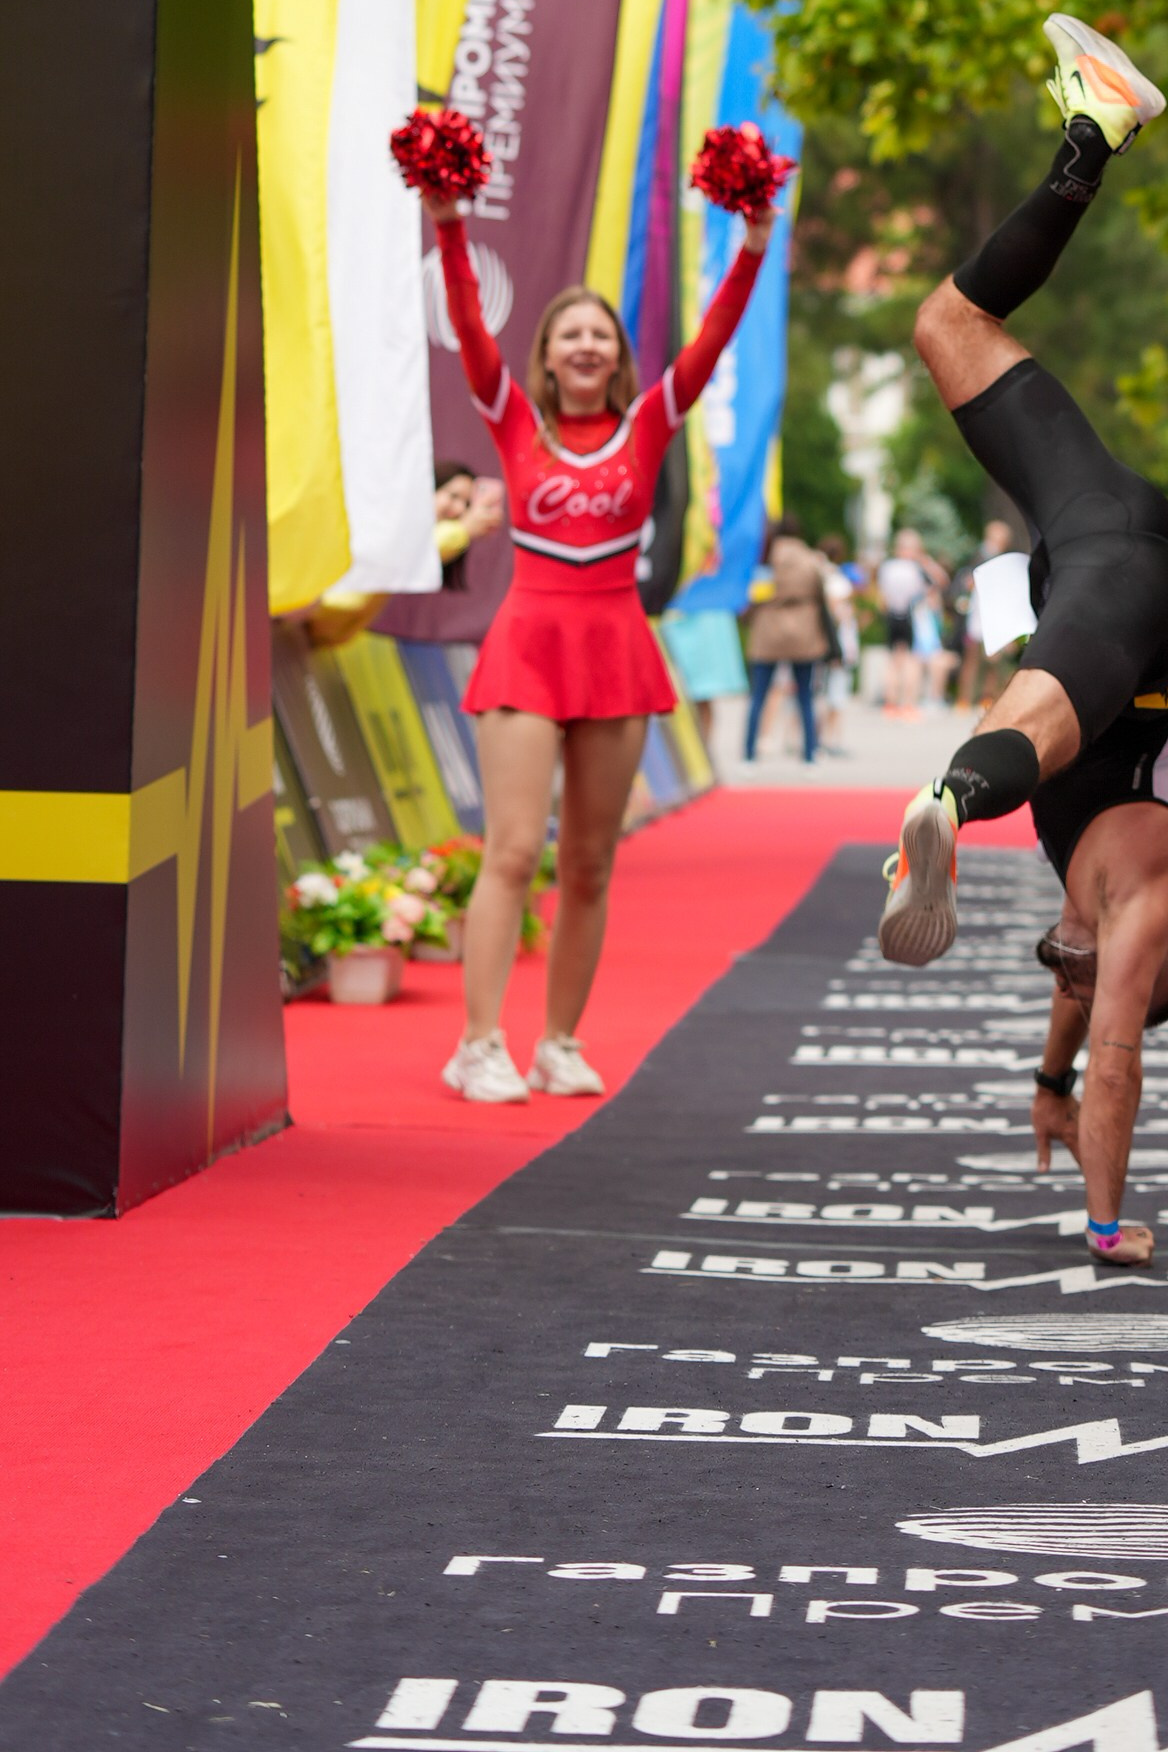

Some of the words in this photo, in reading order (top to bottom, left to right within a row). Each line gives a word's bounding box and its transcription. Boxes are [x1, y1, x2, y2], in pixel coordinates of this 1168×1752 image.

[527, 474, 634, 525] Cool
[690, 1198, 994, 1222] IRON
[652, 1251, 986, 1280] IRON
[553, 1404, 981, 1440] IRON
[375, 1678, 966, 1743] IRON
